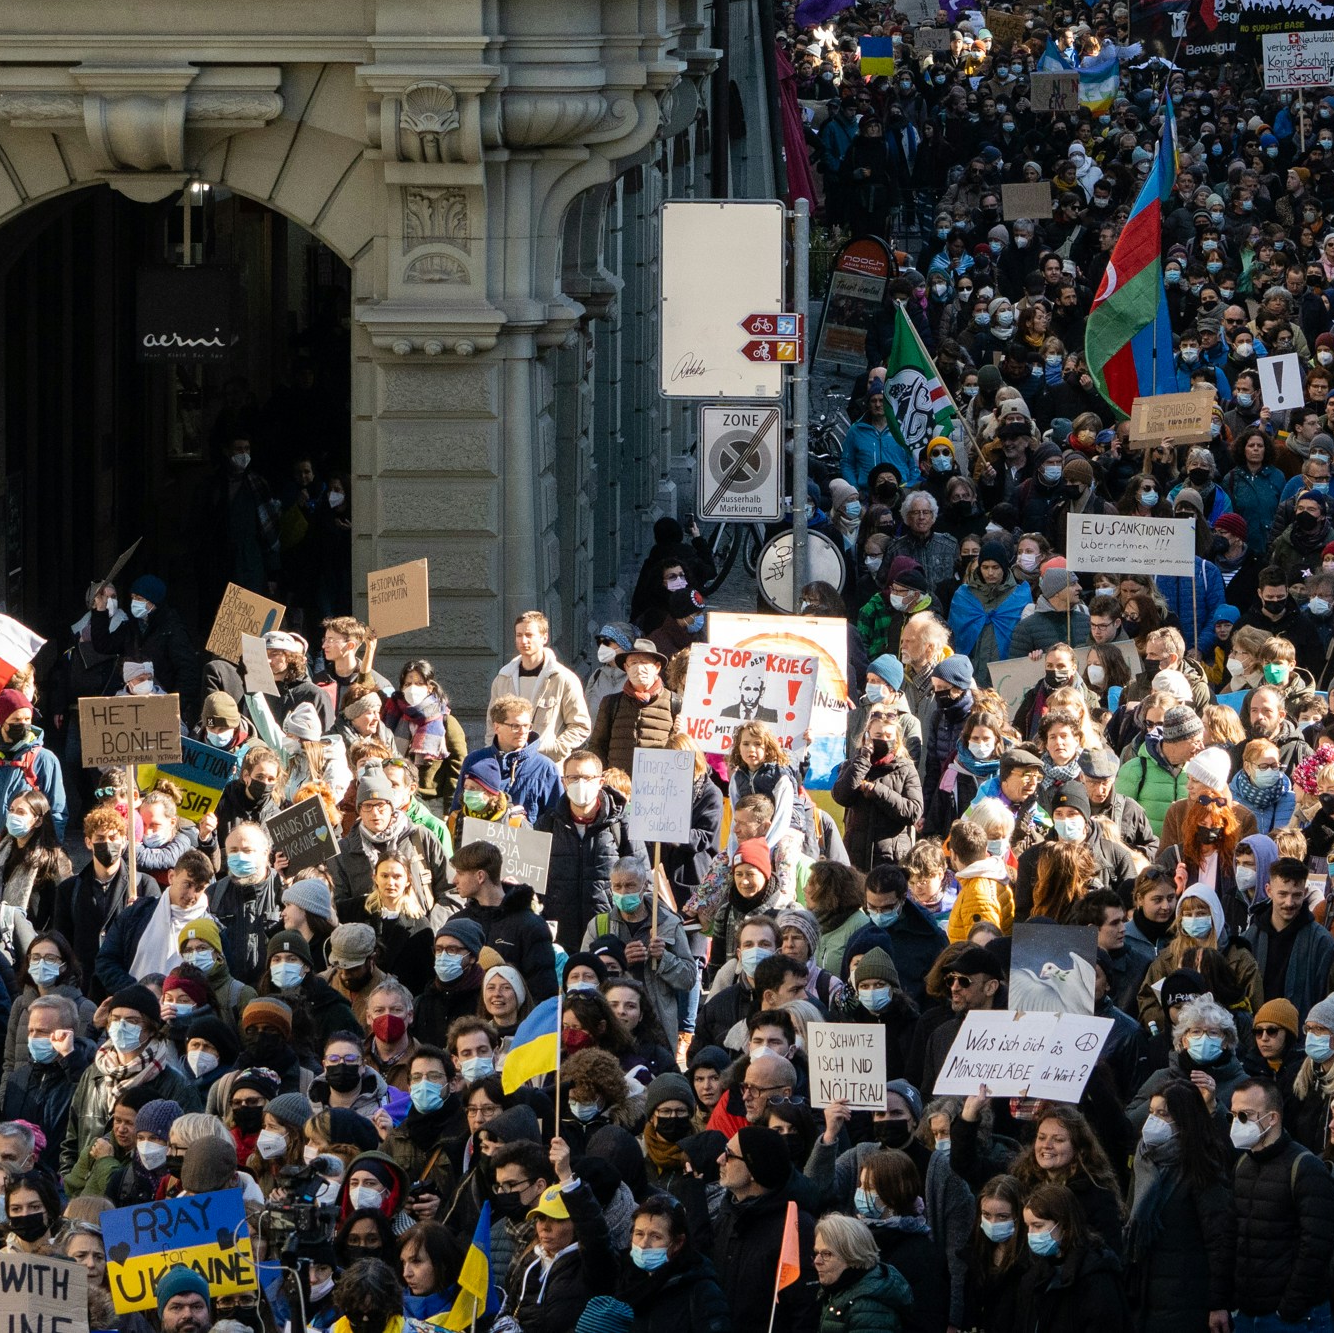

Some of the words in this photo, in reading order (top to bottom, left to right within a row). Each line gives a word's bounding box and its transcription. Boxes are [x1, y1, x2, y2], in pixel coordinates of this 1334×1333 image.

[1268, 55, 1294, 68] Keine
[1268, 70, 1286, 83] mit
[1288, 69, 1334, 84] Russland!
[844, 255, 885, 267] nooch
[143, 327, 226, 347] aerni
[778, 321, 794, 335] 37
[777, 341, 794, 354] 77
[723, 414, 759, 427] ZONE
[721, 494, 761, 504] ausserhalb
[719, 503, 762, 515] Markierung
[1080, 519, 1175, 537] EU-SANKTIONEN
[1080, 538, 1149, 551] übernehmen
[370, 572, 407, 592] #STOPWAR
[704, 646, 750, 669] STOP
[750, 655, 766, 667] DEM
[765, 657, 813, 675] KRIEG
[91, 704, 145, 726] НЕТ
[687, 716, 713, 740] WEG
[715, 724, 731, 735] MIT
[272, 816, 301, 843] HANDS
[301, 806, 319, 824] OFF
[486, 822, 517, 842] BAN
[506, 858, 545, 882] SWIFT
[966, 1028, 996, 1054] Was
[998, 1030, 1019, 1052] isch
[817, 1056, 844, 1073] ISCH
[851, 1057, 873, 1074] NID
[946, 1055, 1035, 1082] MÖNSCHELÄBE
[131, 1196, 213, 1243] PRAY
[159, 1248, 188, 1264] for
[0, 1258, 69, 1302] WITH
